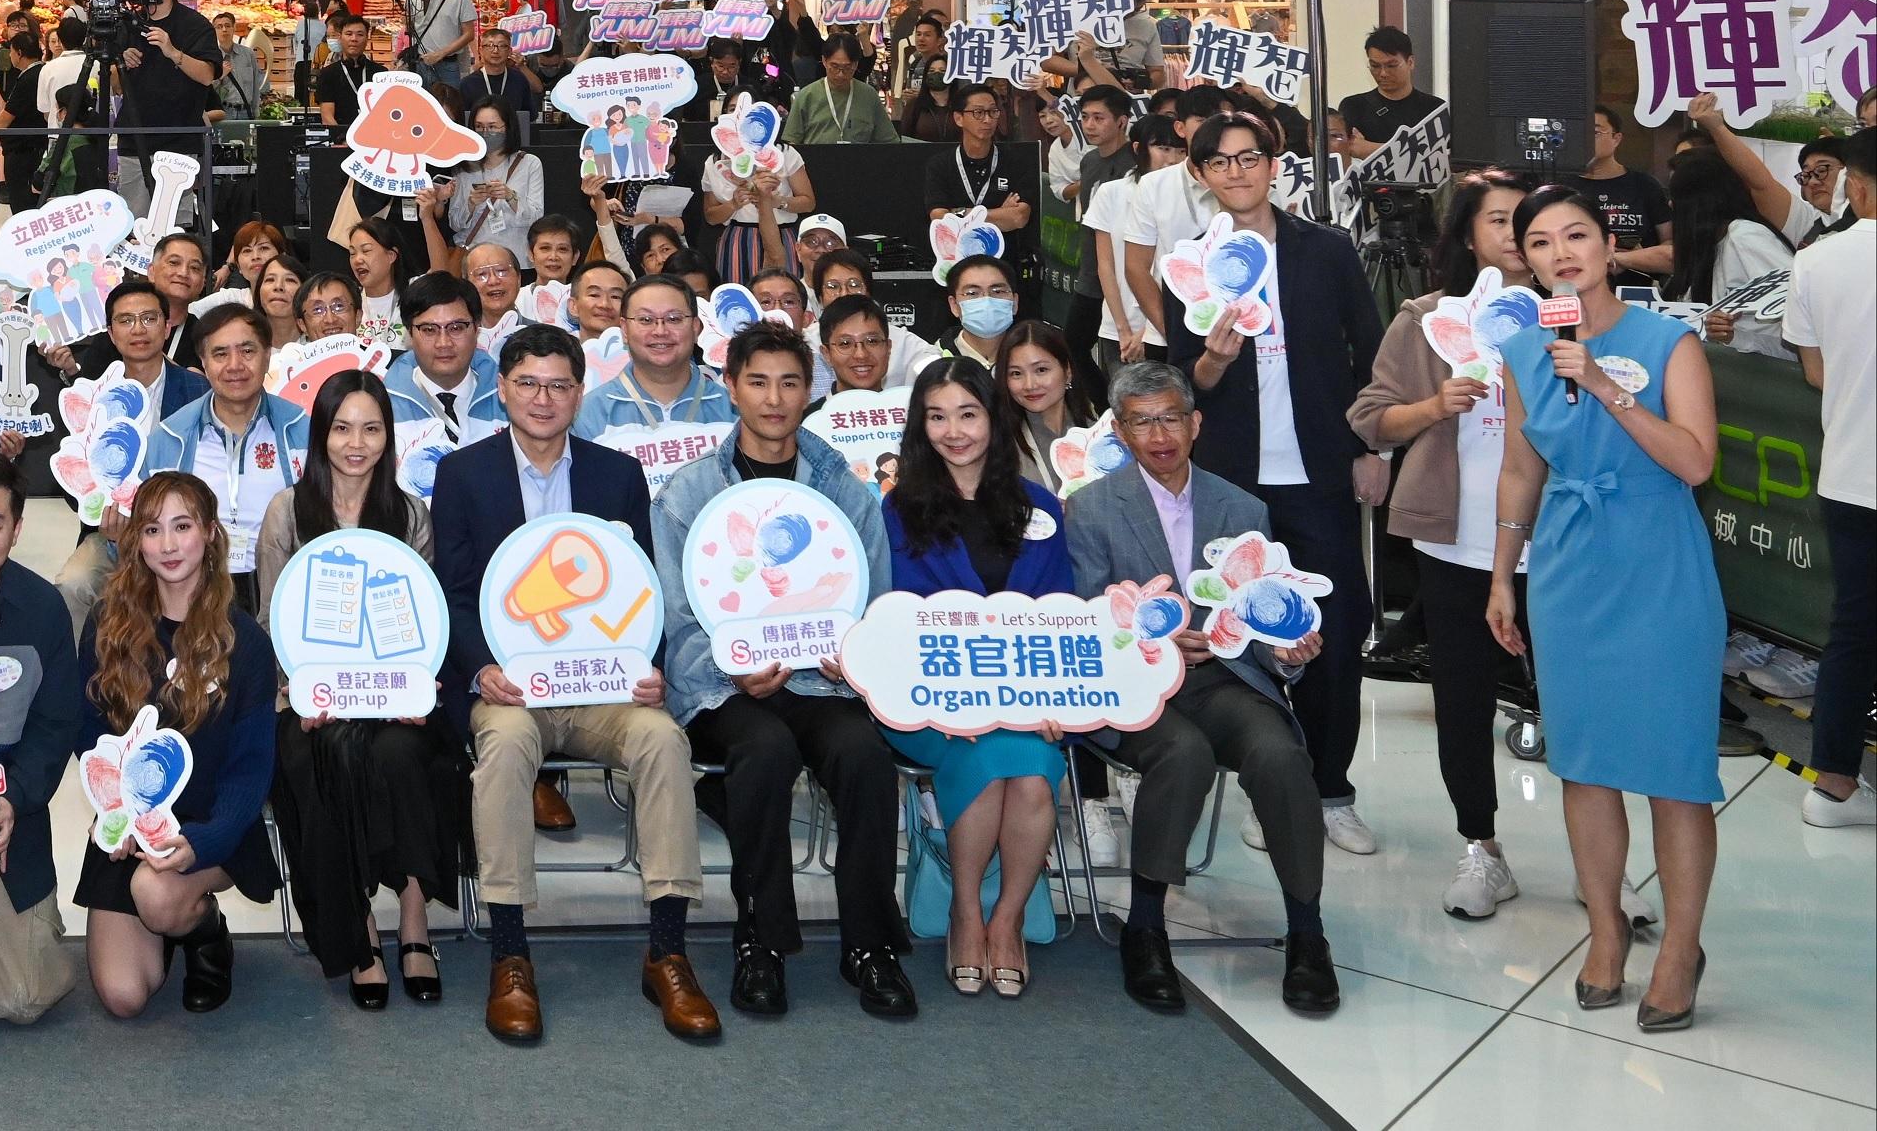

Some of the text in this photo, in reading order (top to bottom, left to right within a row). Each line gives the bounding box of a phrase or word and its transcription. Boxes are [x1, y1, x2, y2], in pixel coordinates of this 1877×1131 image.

[592, 17, 658, 41] YUMI
[704, 12, 773, 38] YUMI
[645, 26, 705, 50] YUMI
[576, 66, 669, 90] 支持器官捐贈!
[576, 81, 674, 100] Support Organ Donation!
[11, 201, 95, 246] 立即登記!
[24, 223, 95, 257] Register Now!
[325, 338, 357, 353] Support
[831, 430, 905, 445] Support Orga
[761, 619, 836, 641] 傳播希望
[916, 611, 1097, 630] 全民響應 Let's Support
[730, 636, 840, 666] Spread-out
[918, 635, 1104, 679] 器官捐贈
[336, 670, 408, 691] 登記意願
[553, 658, 627, 679] 告訴家人
[312, 682, 388, 709] Sign-up
[529, 671, 629, 699] Speak-out
[910, 685, 1121, 712] Organ Donation
